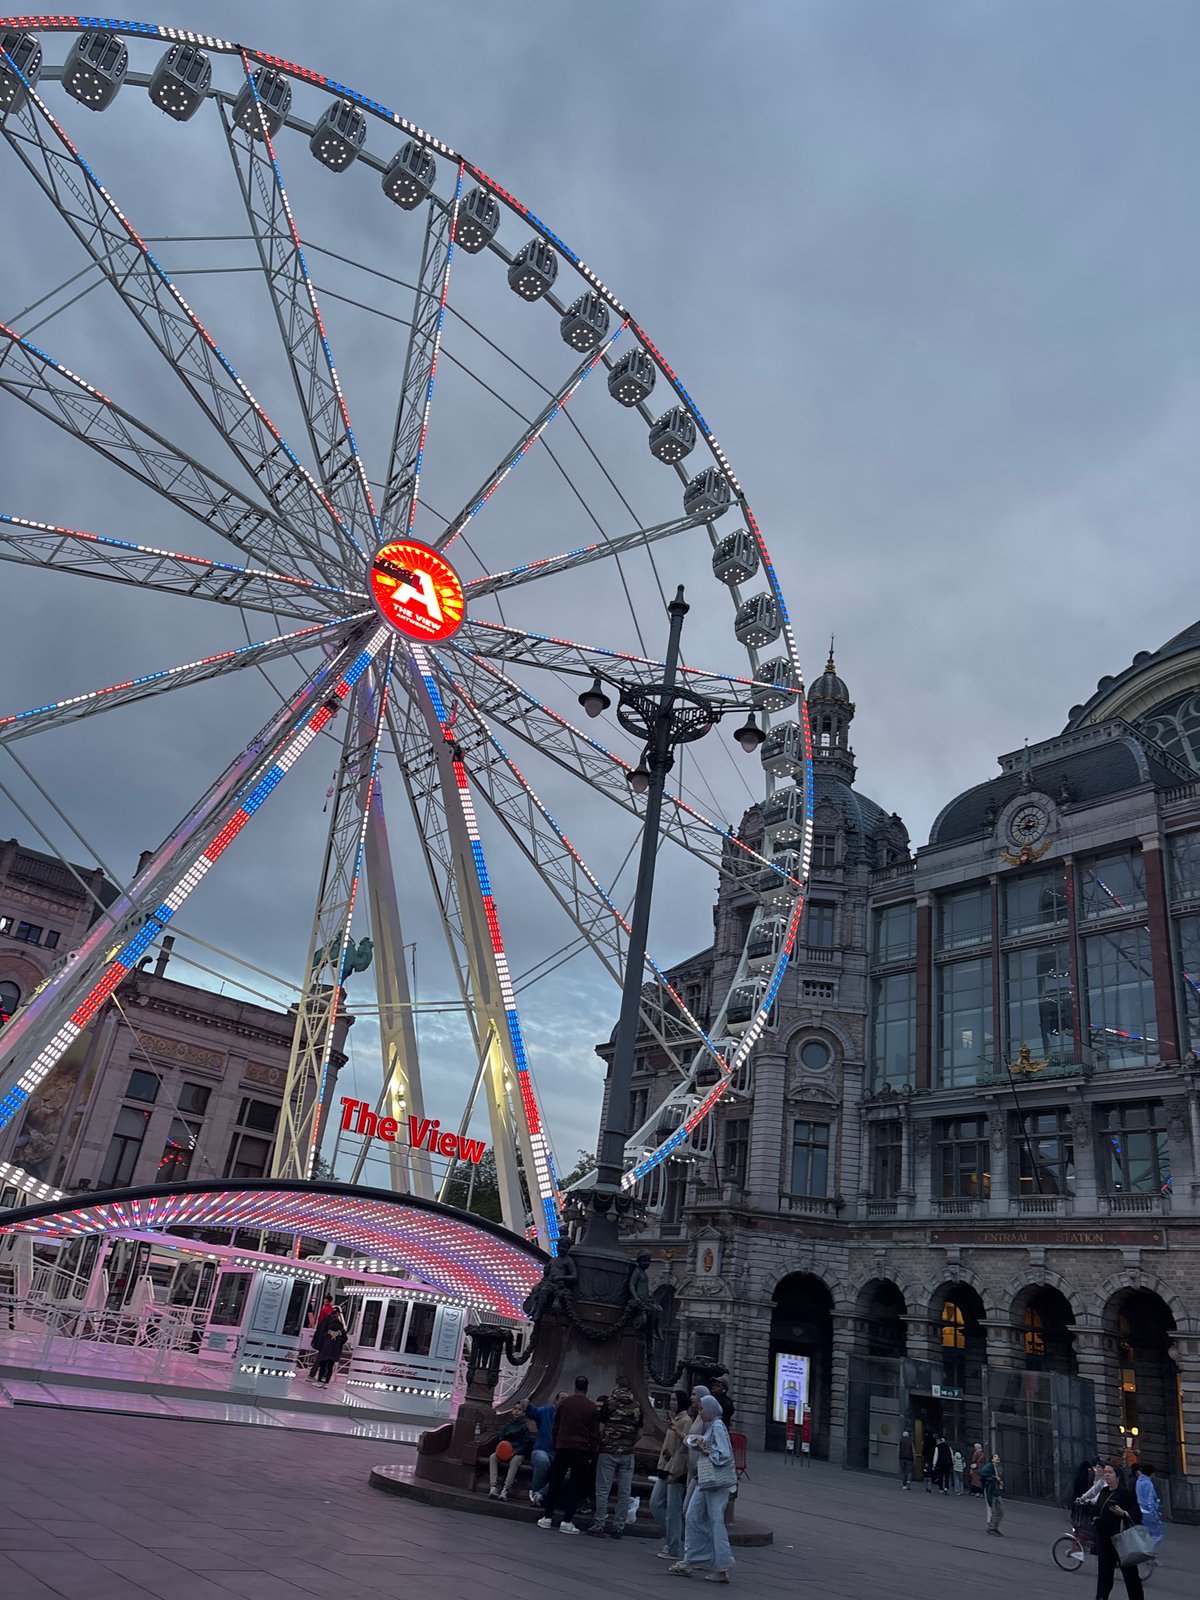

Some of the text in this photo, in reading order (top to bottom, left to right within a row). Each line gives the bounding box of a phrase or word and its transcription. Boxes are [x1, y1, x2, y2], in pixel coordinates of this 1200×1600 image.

[393, 603, 441, 631] THE VIEW
[396, 613, 435, 634] ANTWERPEN
[340, 1096, 486, 1165] The View
[977, 1232, 1104, 1242] CENTRAAL STATION
[380, 1364, 418, 1376] Welcome
